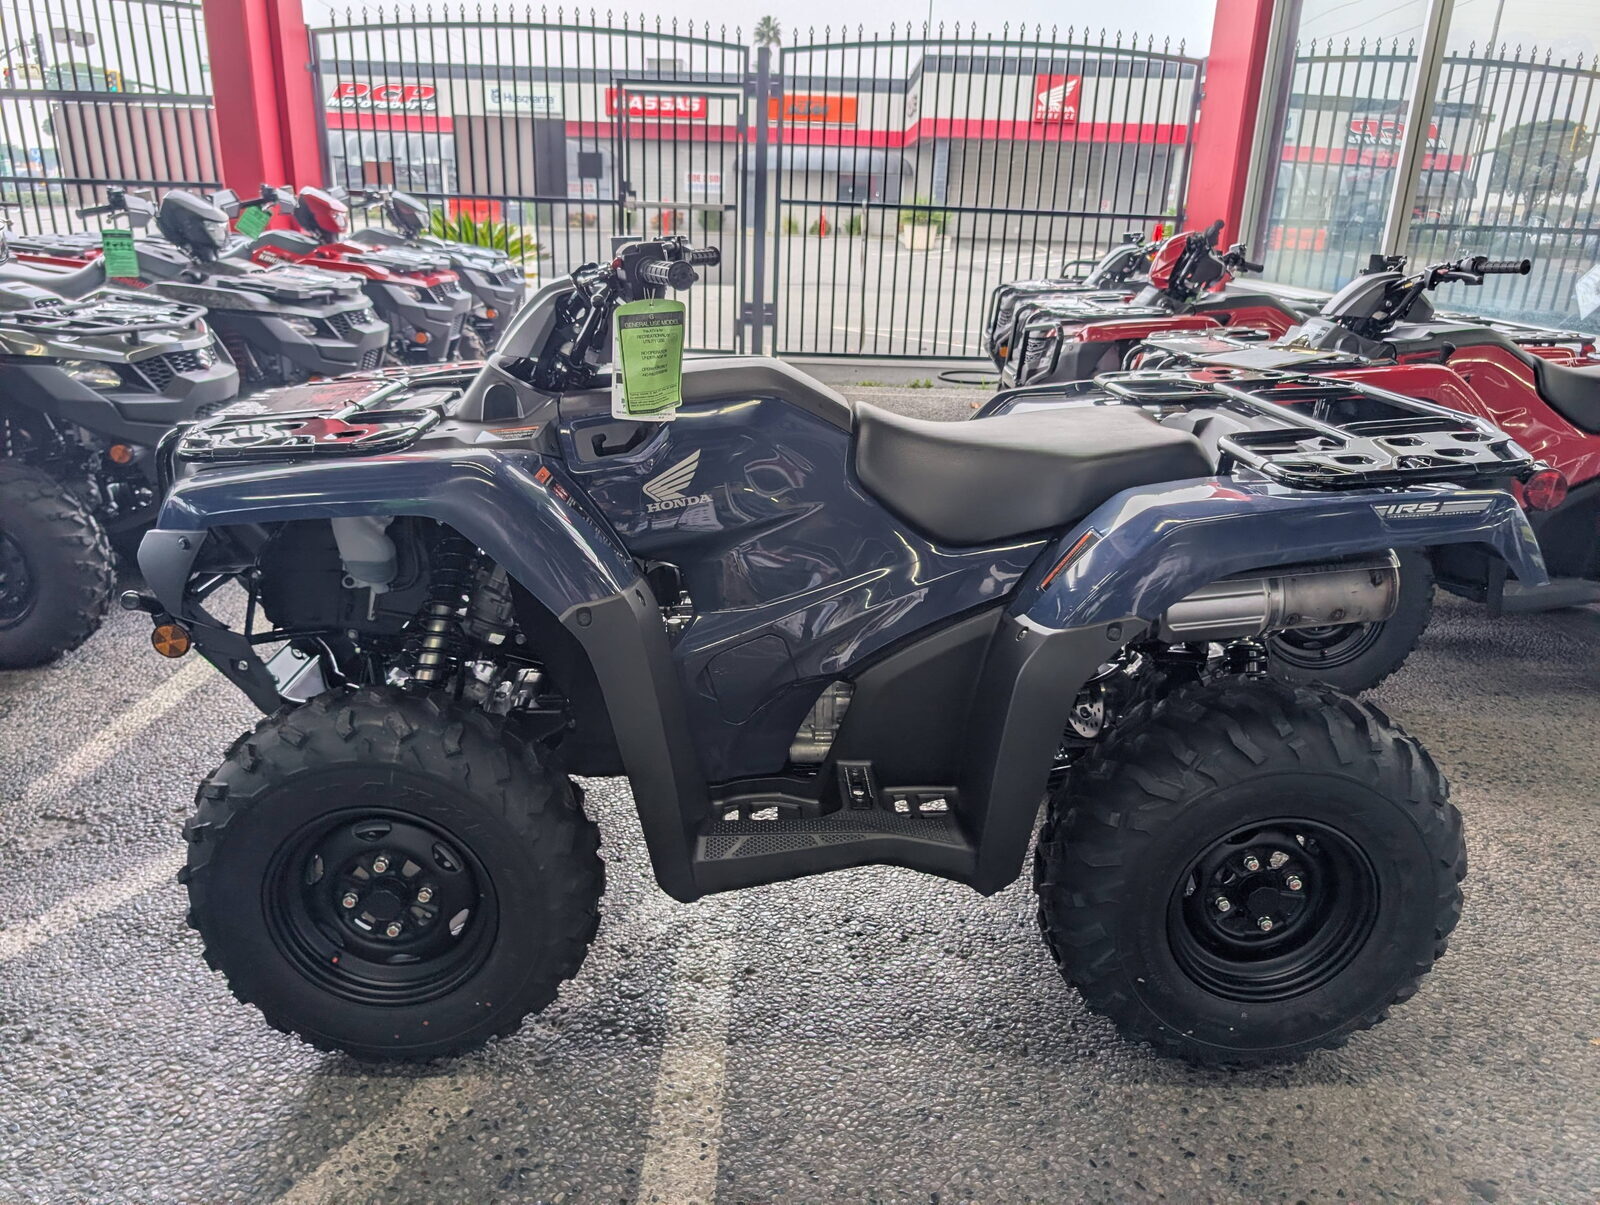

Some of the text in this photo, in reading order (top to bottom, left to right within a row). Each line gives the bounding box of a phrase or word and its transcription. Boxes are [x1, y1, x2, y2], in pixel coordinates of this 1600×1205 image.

[624, 321, 649, 329] GENERAL
[661, 318, 679, 326] MODEL
[645, 494, 714, 514] HONDA
[1387, 502, 1440, 514] IRS
